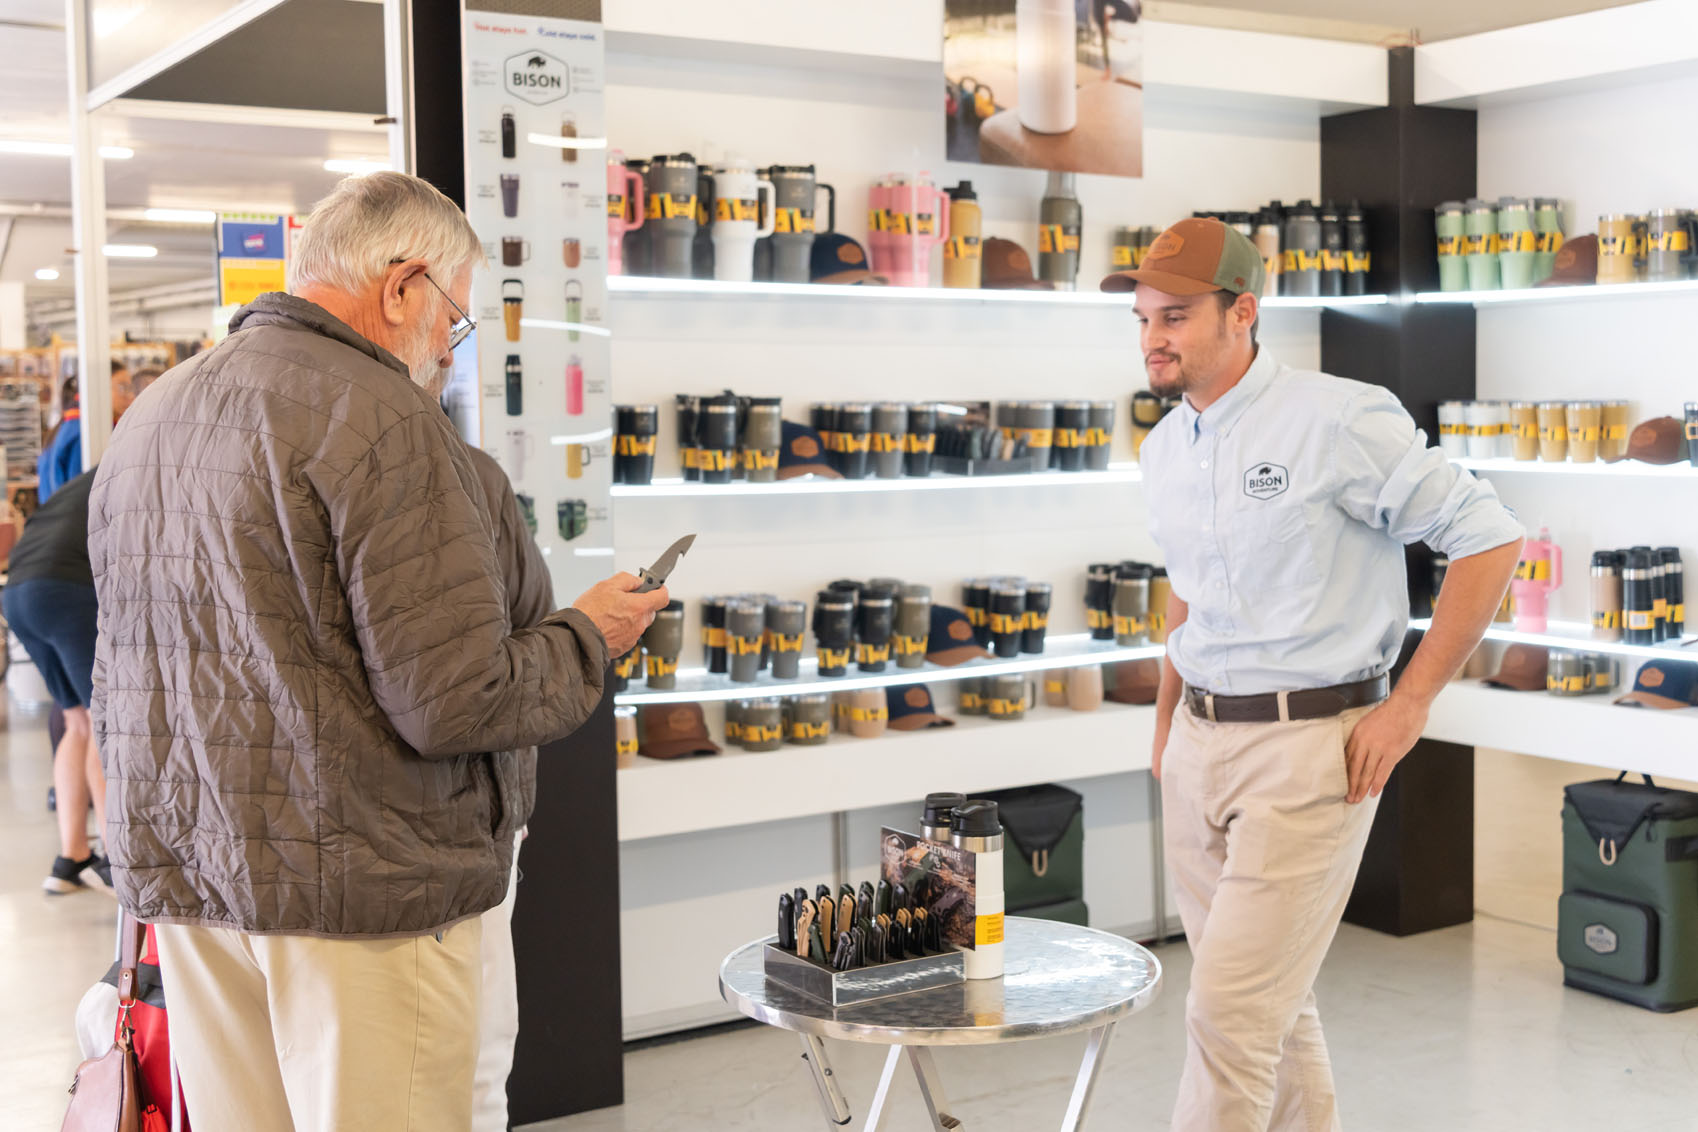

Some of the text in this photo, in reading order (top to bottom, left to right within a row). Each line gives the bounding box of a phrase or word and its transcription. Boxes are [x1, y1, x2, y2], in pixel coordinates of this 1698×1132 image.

[512, 72, 561, 88] BISON
[1249, 476, 1282, 489] BISON
[942, 848, 961, 861] KNIFE
